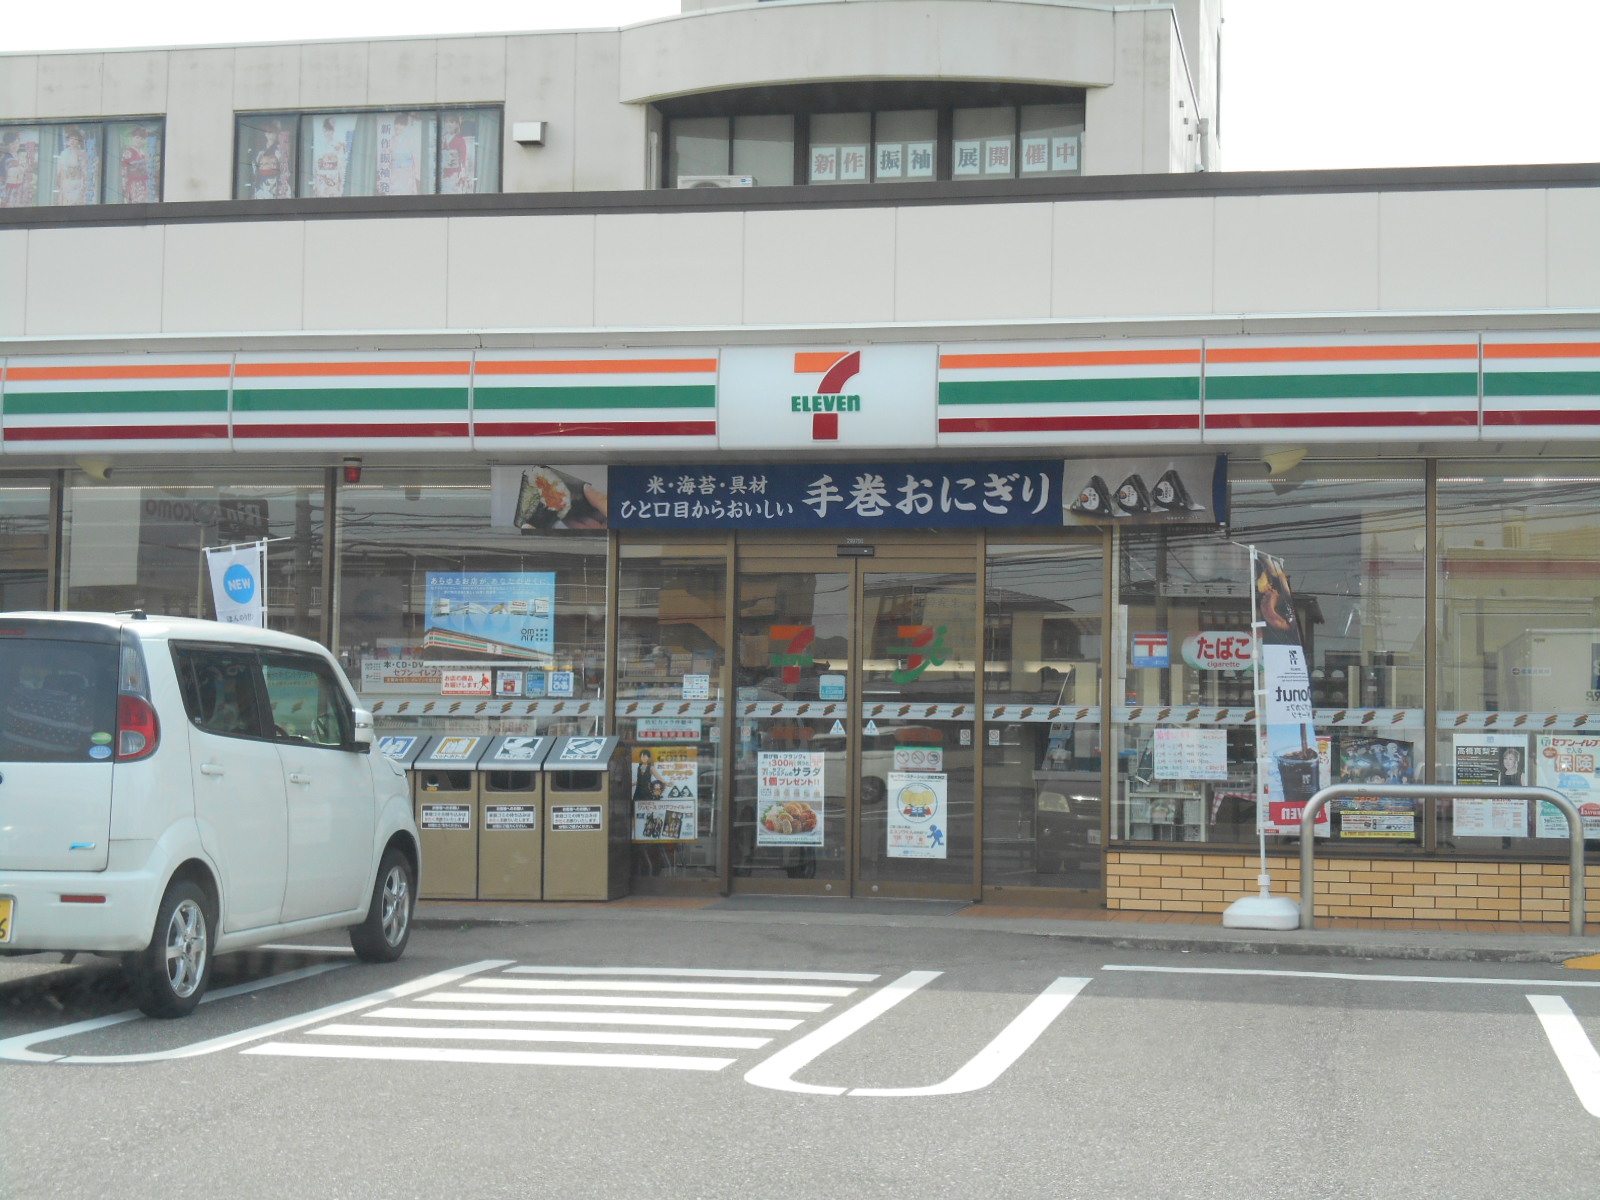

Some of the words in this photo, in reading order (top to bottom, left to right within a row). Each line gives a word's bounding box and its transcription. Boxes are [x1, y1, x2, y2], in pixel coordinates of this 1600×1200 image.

[646, 475, 768, 495] 米・海苔・具材
[802, 473, 1050, 518] 手巻おにぎり
[621, 500, 793, 519] ひと口目からおいしい
[227, 578, 251, 591] NEW
[1197, 636, 1251, 660] たばこ
[1457, 747, 1499, 756] 高橋真梨子
[793, 767, 821, 776] サラダ
[1555, 754, 1594, 773] 保険
